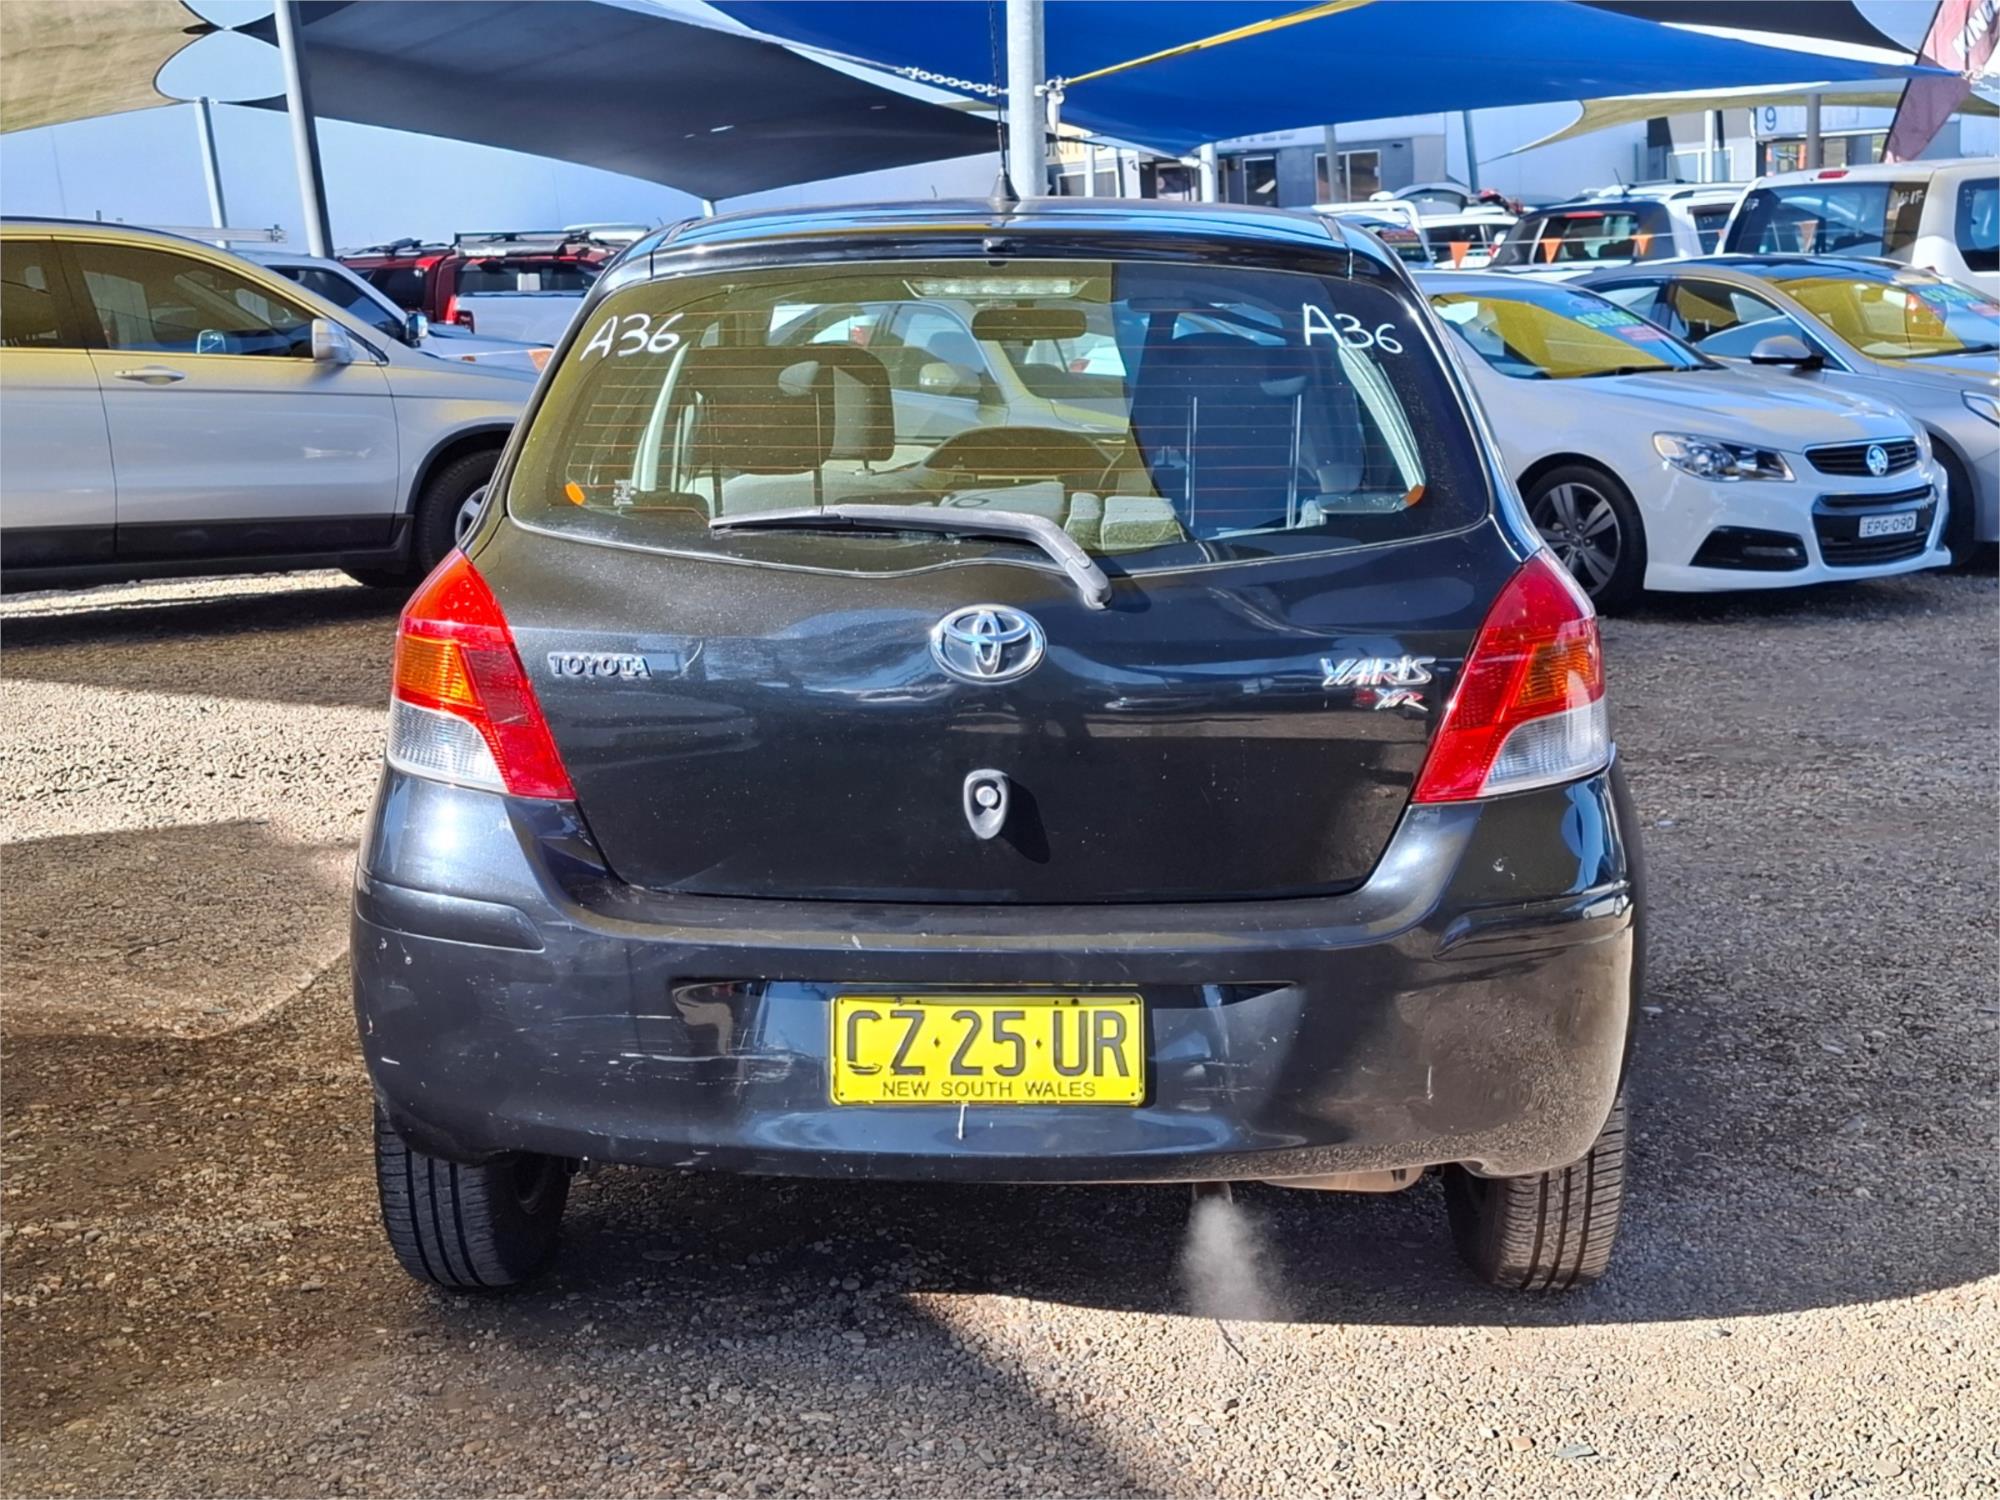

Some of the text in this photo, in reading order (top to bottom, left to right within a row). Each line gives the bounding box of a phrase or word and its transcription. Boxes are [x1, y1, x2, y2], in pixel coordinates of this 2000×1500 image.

[1765, 106, 1777, 131] 9
[579, 312, 684, 361] A36
[1302, 303, 1403, 354] A36
[546, 652, 652, 680] TOYOTA
[1320, 655, 1436, 687] YARIS
[882, 1081, 1096, 1097] NEW SOUTH WALES
